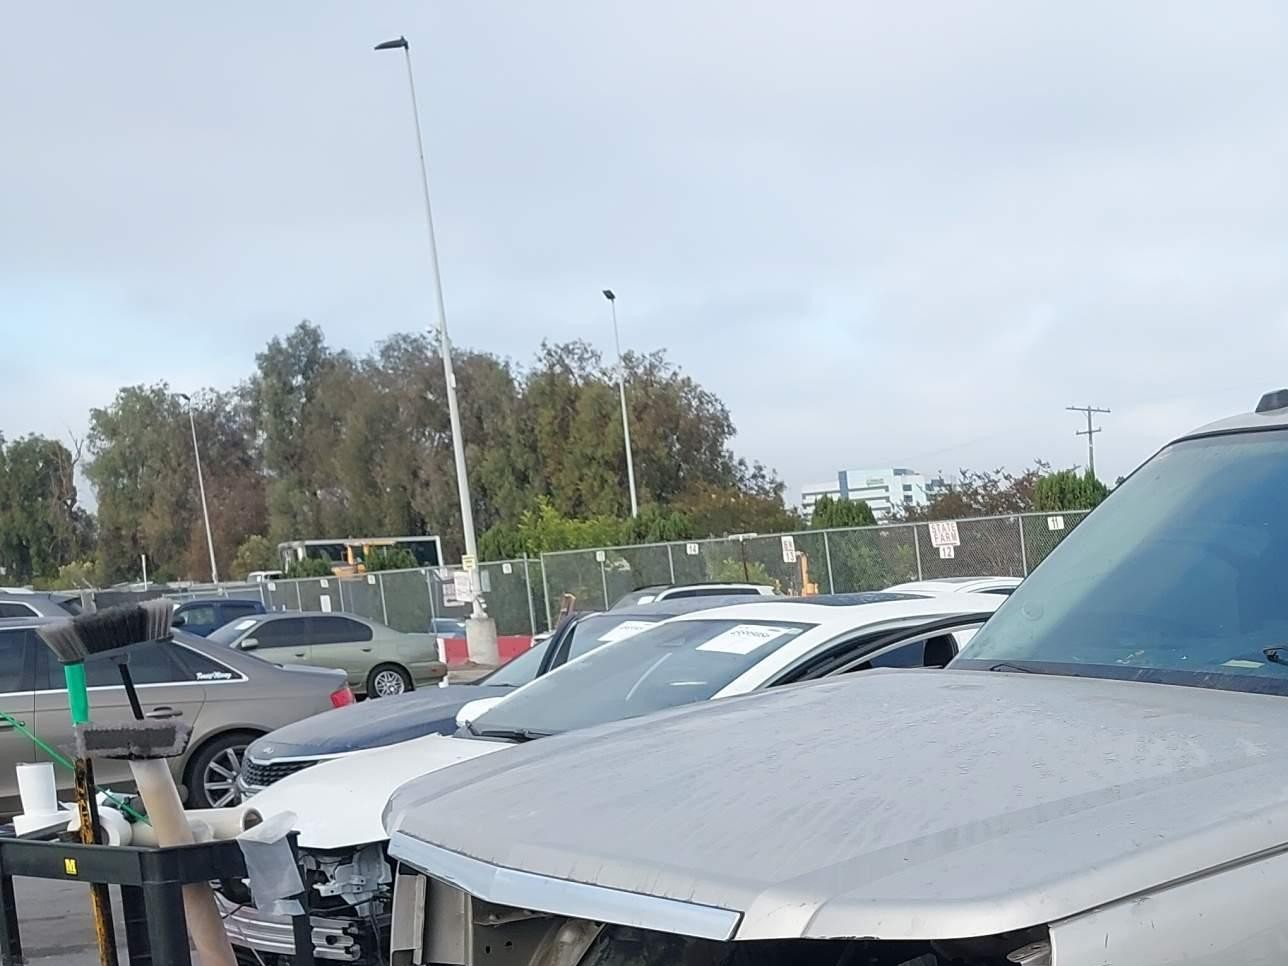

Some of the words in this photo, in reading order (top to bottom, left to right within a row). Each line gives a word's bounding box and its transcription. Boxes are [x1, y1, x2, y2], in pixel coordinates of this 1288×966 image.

[931, 522, 957, 534] STATE
[934, 531, 958, 543] FARM
[942, 546, 952, 557] 12
